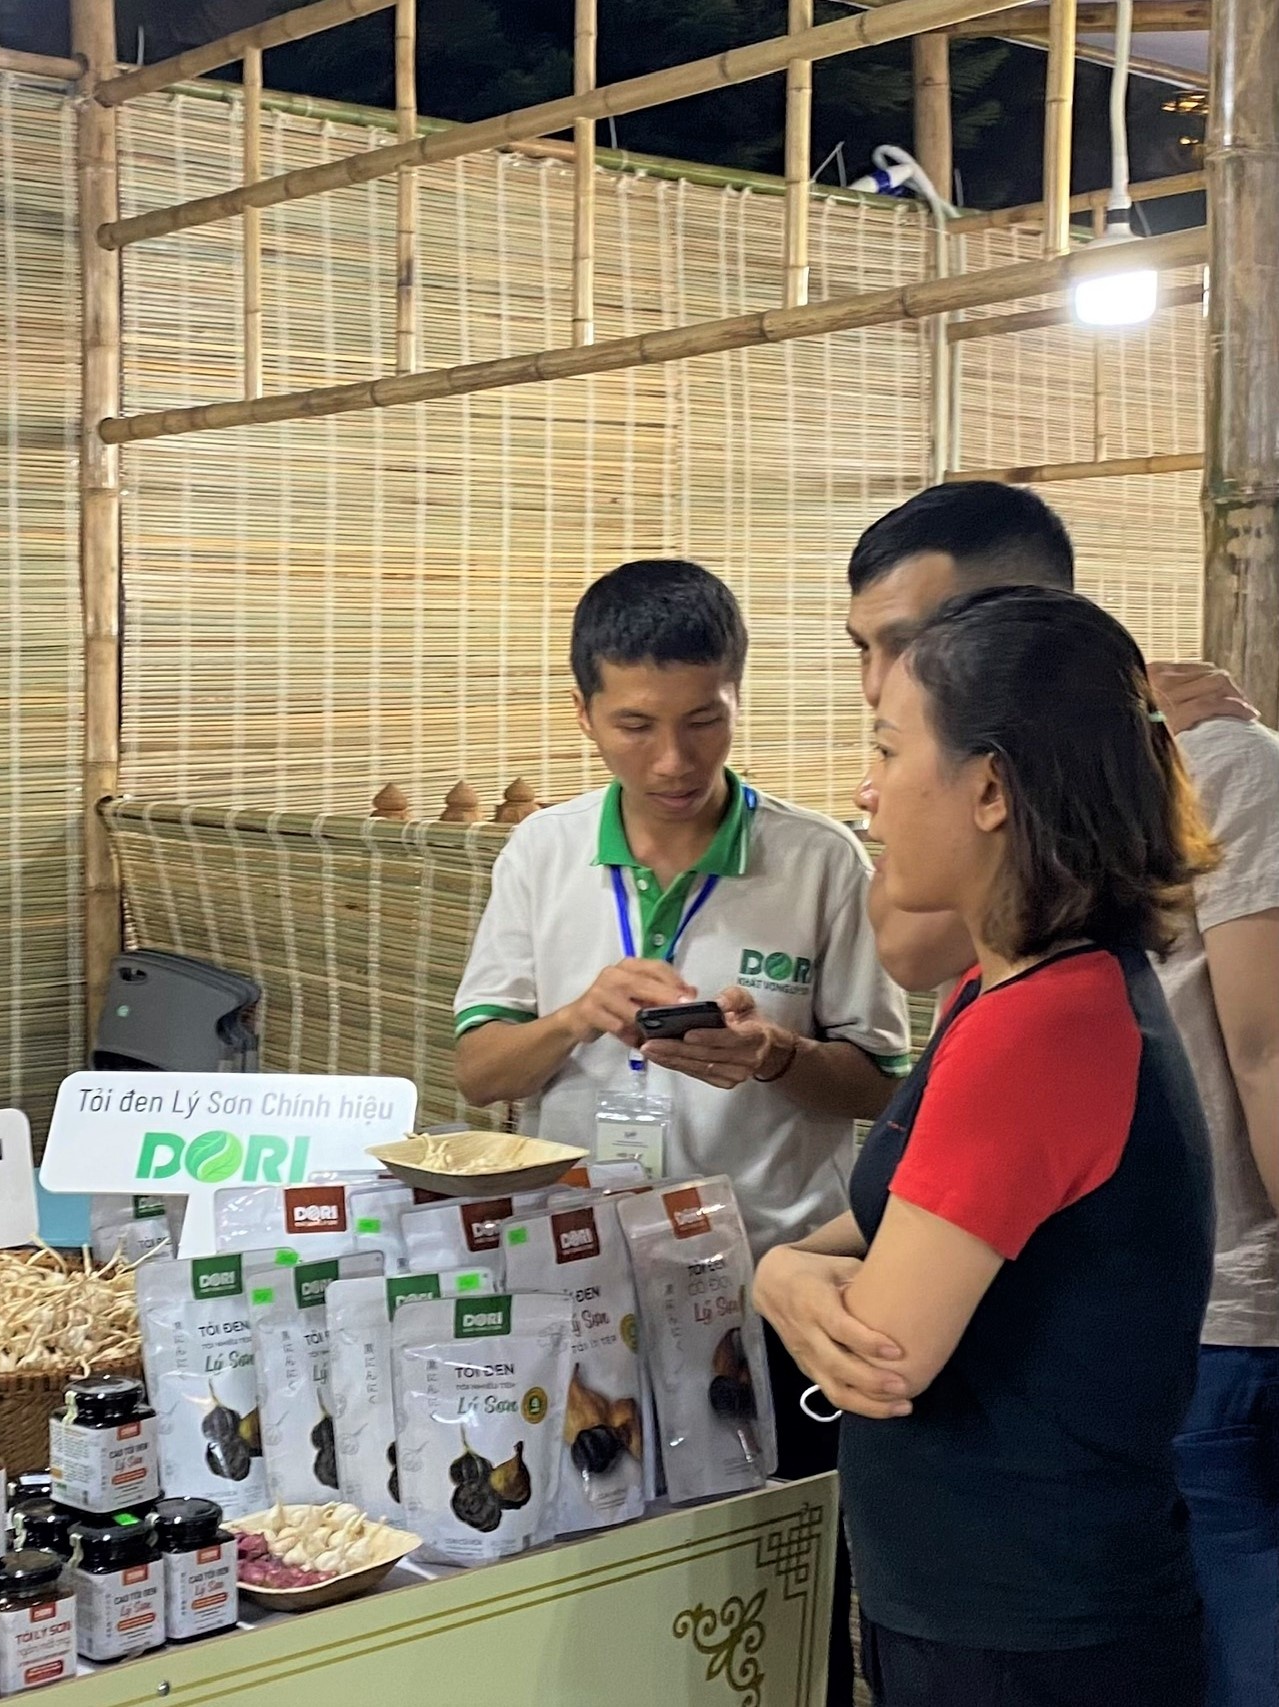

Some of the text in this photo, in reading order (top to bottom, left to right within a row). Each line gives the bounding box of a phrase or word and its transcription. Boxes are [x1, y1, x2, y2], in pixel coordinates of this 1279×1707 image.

[78, 1088, 395, 1126] Tỏi đen Lý Sơn Chính hiệu
[135, 1130, 311, 1184] DORI
[293, 1204, 339, 1222] DORI
[198, 1270, 237, 1289] DORI
[198, 1320, 221, 1338] TỎI
[462, 1311, 504, 1329] DORI
